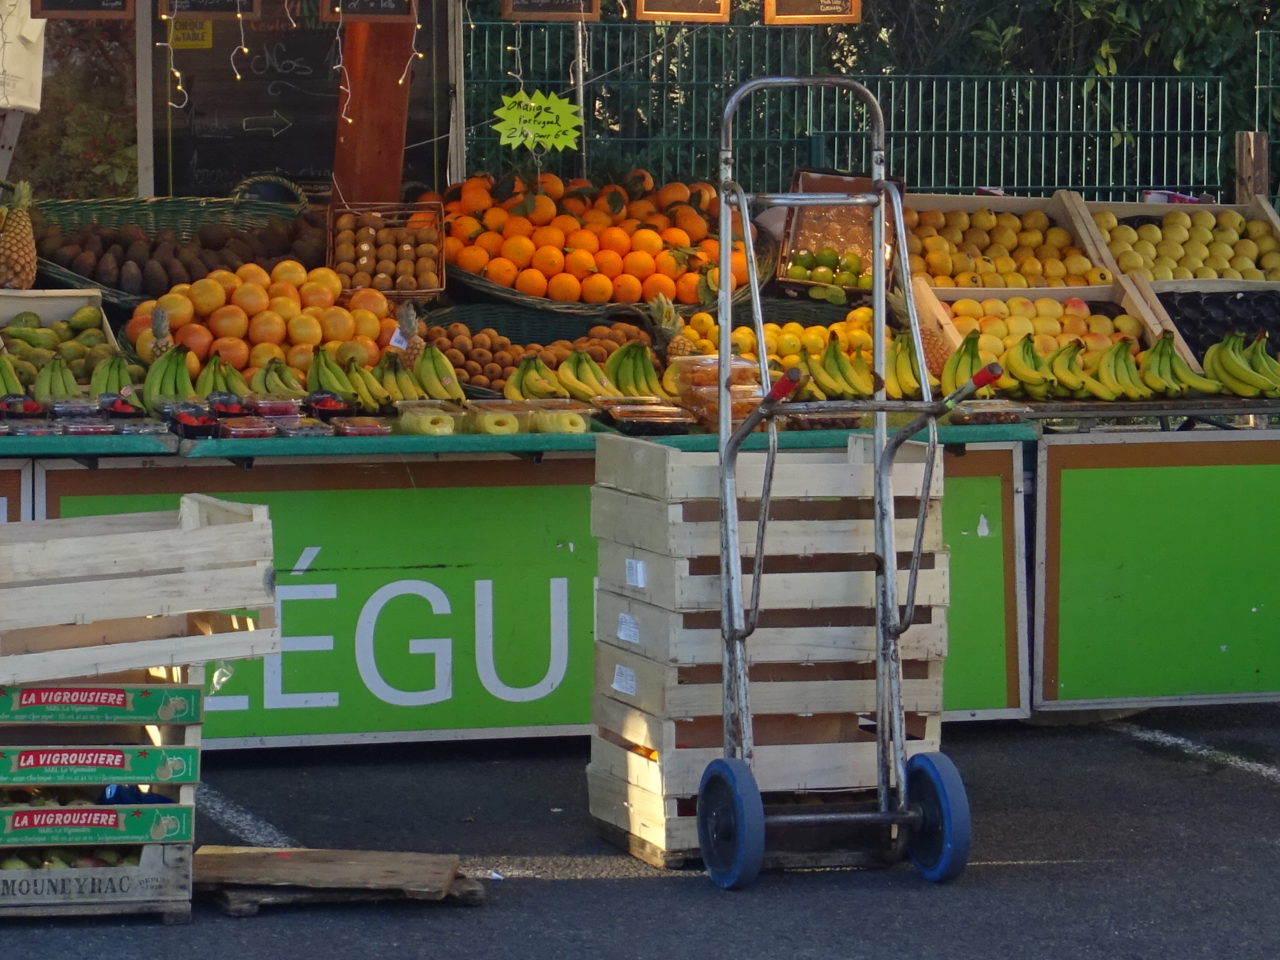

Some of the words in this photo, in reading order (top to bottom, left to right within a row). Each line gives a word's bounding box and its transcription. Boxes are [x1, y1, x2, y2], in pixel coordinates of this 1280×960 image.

[21, 692, 36, 705] LA
[40, 690, 125, 705] VIGROUSIERE
[19, 754, 35, 767] LA
[39, 752, 123, 766] VIGROUSIERE
[13, 814, 29, 827] LA
[32, 812, 117, 826] VIGROUSIERE
[1, 876, 130, 896] MOUNEYRAC
